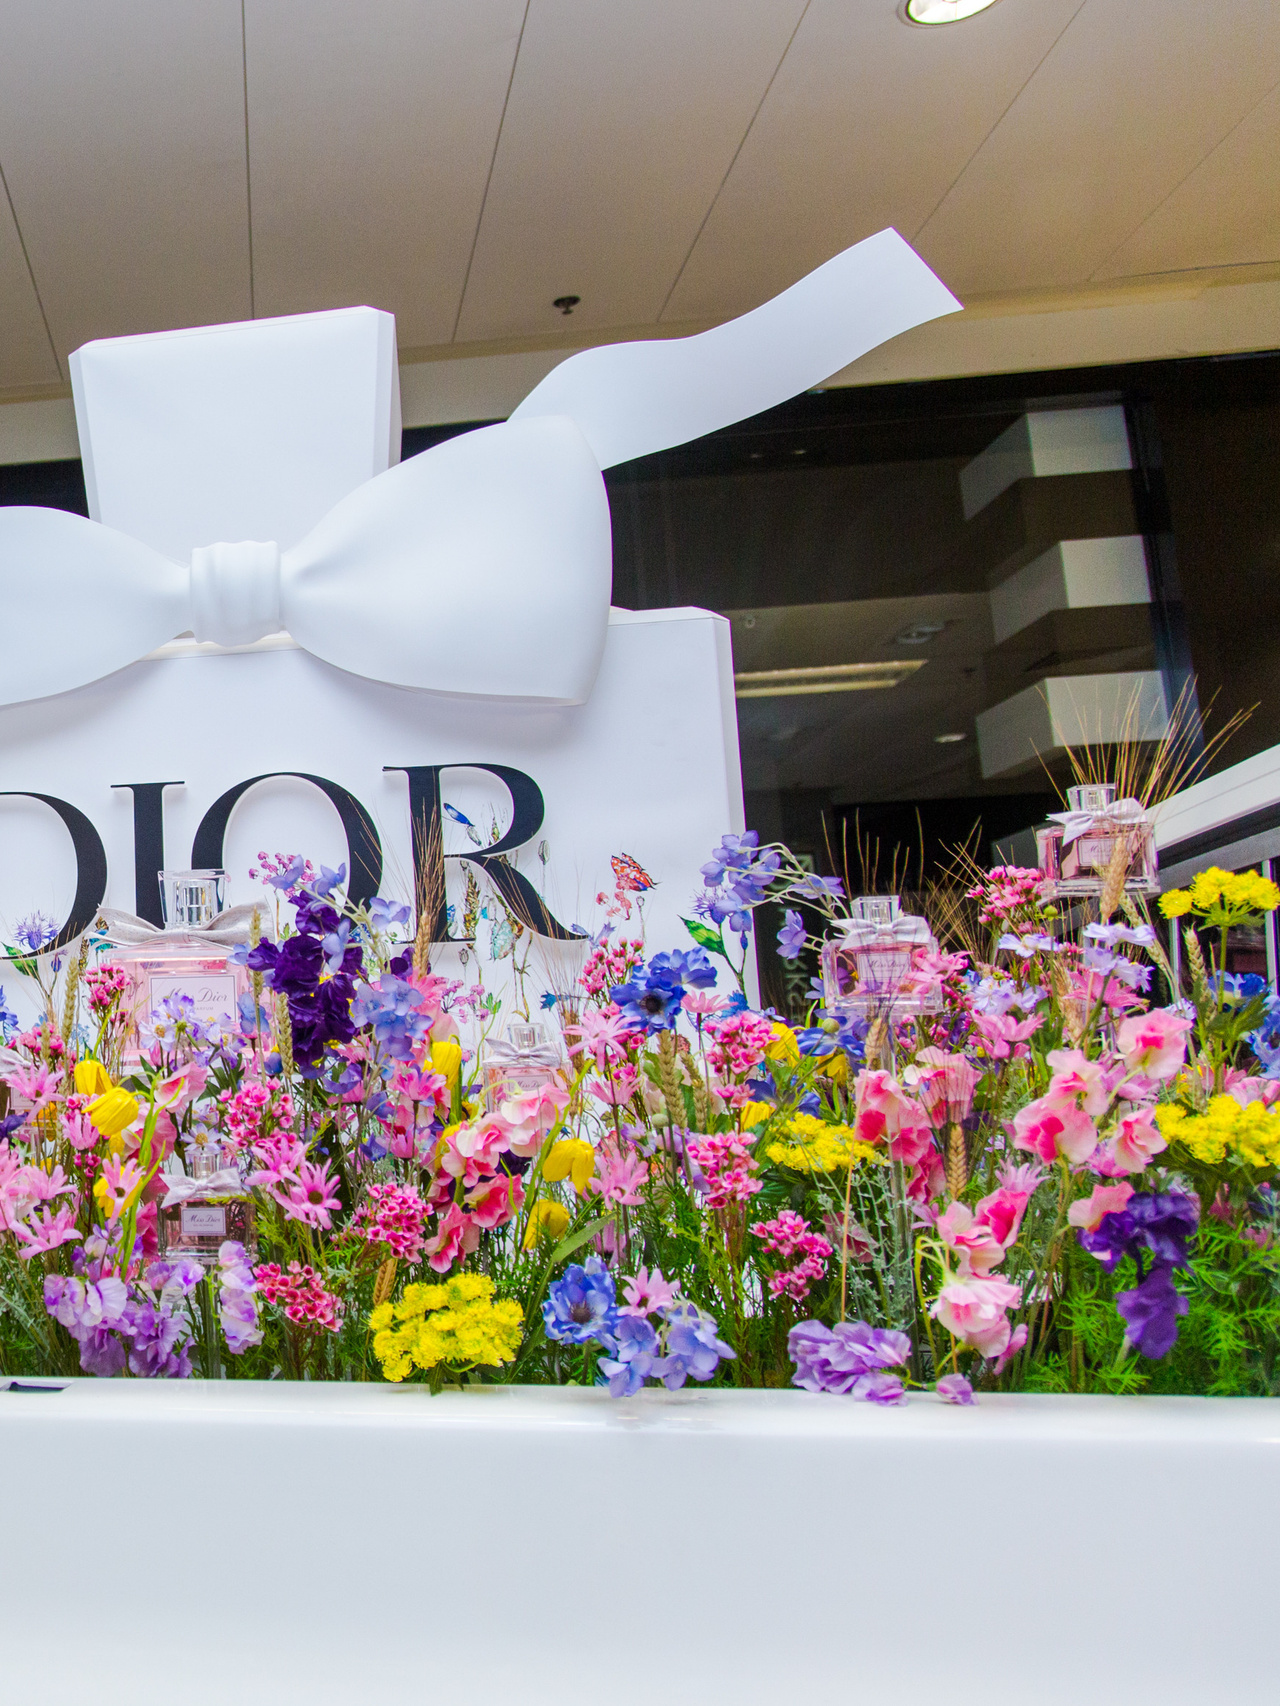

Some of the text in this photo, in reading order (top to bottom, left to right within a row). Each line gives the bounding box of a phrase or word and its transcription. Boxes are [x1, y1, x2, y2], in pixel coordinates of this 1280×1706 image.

[197, 987, 228, 1002] Dior
[189, 1214, 221, 1222] Miss Dior
